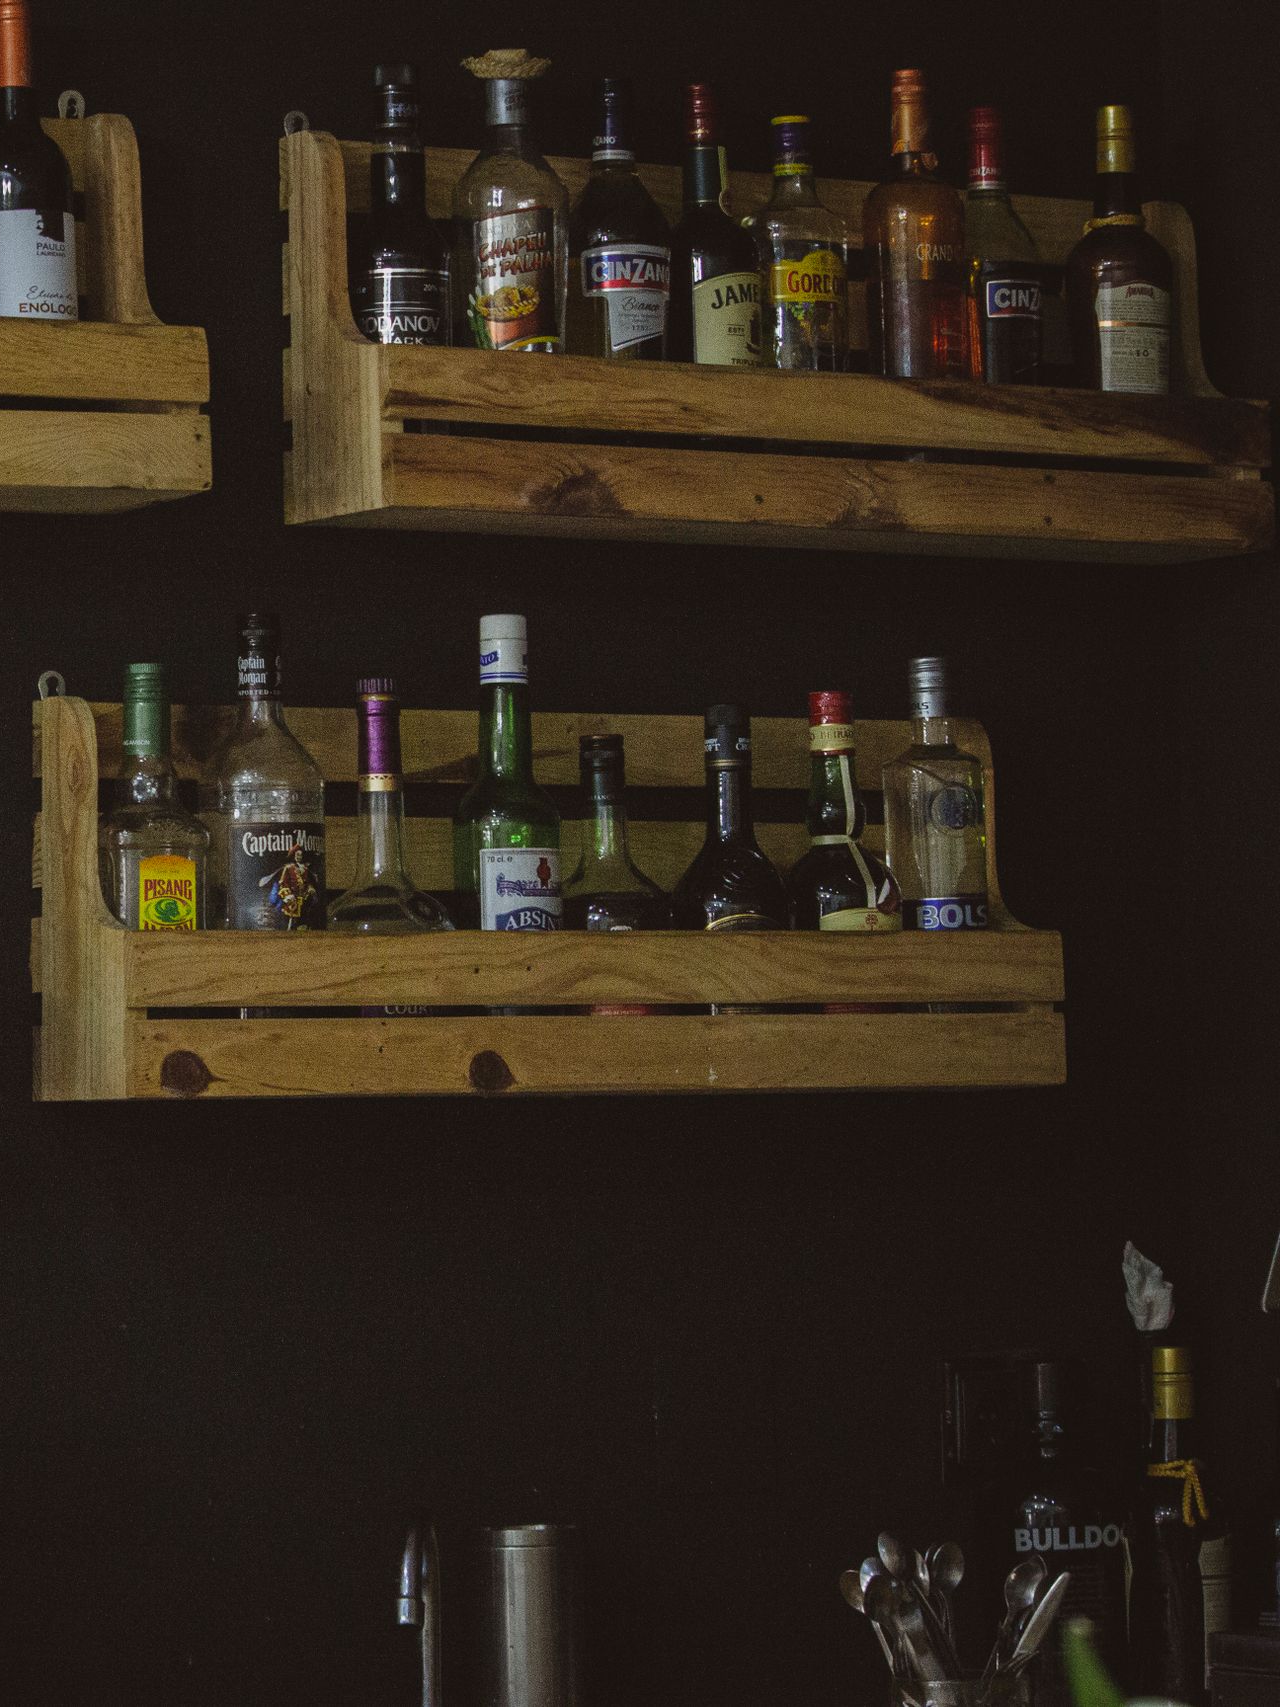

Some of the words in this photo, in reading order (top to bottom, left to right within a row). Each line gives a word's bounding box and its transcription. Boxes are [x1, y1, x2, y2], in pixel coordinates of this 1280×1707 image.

[591, 258, 670, 284] CINZANO
[238, 656, 266, 672] Captain
[238, 671, 267, 687] Morgan
[241, 831, 291, 857] Captain
[144, 879, 192, 901] PISANG
[505, 910, 558, 931] ABSIN
[917, 904, 988, 930] BOLS
[1015, 1523, 1122, 1552] BULLDO
